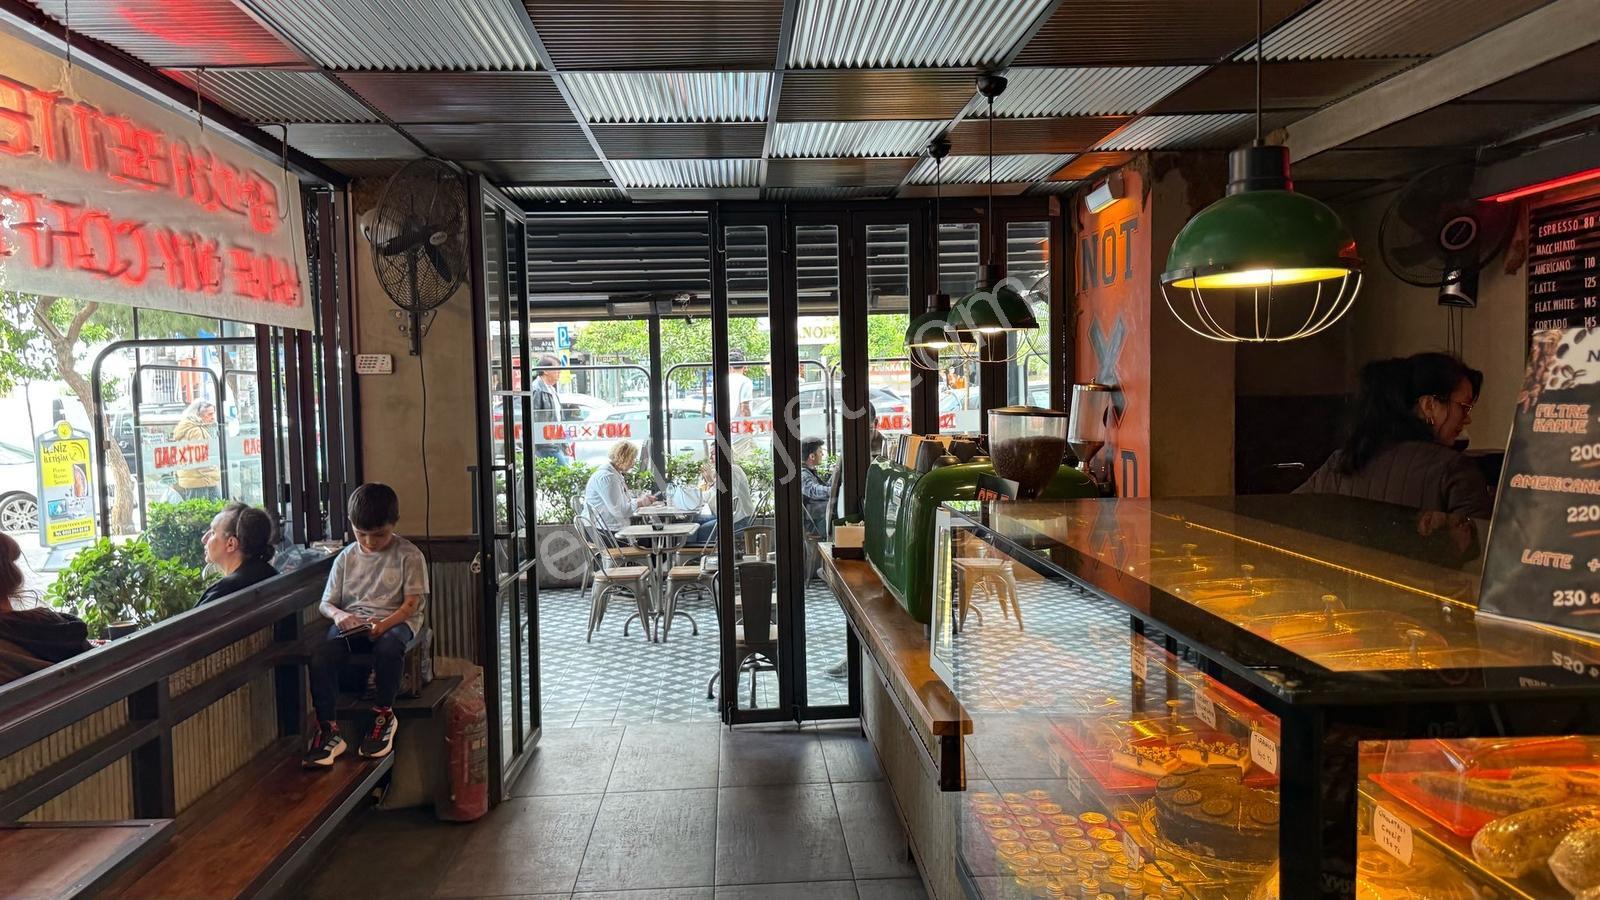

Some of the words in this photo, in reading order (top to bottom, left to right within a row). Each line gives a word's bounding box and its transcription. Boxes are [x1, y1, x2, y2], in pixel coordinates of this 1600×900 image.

[1538, 219, 1579, 238] ESPRESSO
[1584, 216, 1595, 229] 80
[1081, 217, 1138, 290] NOT
[1536, 239, 1576, 256] MACCHIATO
[1534, 259, 1571, 276] AMERICANO
[1584, 256, 1596, 269] 110
[1534, 281, 1557, 294] LATTE
[1584, 276, 1597, 289] 125
[1534, 301, 1552, 313] FLAT
[1553, 298, 1576, 310] WHITE
[1570, 443, 1600, 462] 200
[1567, 505, 1600, 523] 220
[1521, 548, 1573, 570] LATTE
[1552, 590, 1586, 607] 230
